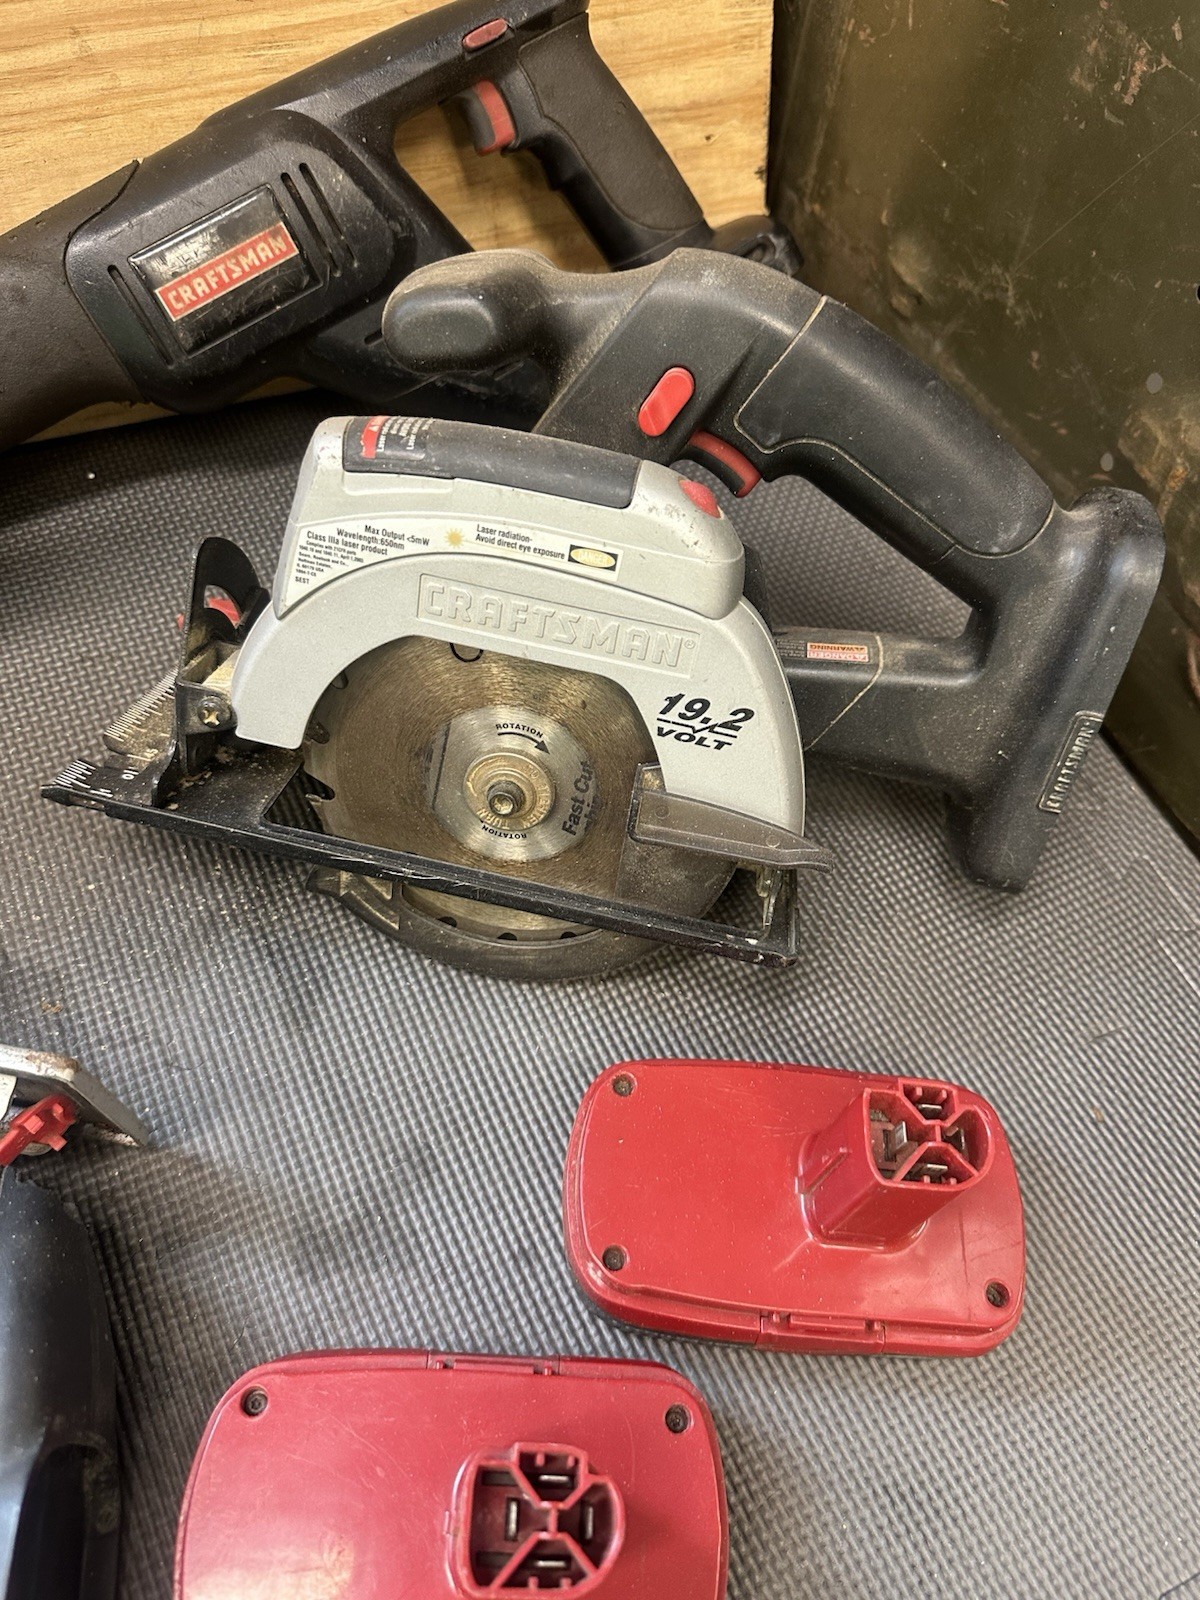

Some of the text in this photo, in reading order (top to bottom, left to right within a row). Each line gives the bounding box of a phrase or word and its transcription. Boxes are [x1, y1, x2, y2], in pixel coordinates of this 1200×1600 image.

[167, 234, 288, 310] CRAFTSMAN
[337, 528, 405, 550] Wavelength:650nm
[364, 525, 430, 546] Max Output <5mW
[476, 524, 497, 536] Laser
[307, 531, 327, 542] Class
[342, 538, 359, 549] laser
[361, 543, 388, 555] product
[476, 534, 565, 560] Avoid direct eye exposure
[810, 644, 857, 652] WARNING
[659, 693, 756, 733] 19.2
[495, 723, 544, 738] ROTATION
[656, 727, 733, 751] VOLT
[562, 796, 584, 836] Fast
[574, 760, 594, 794] Cut
[481, 824, 527, 840] ROTATION
